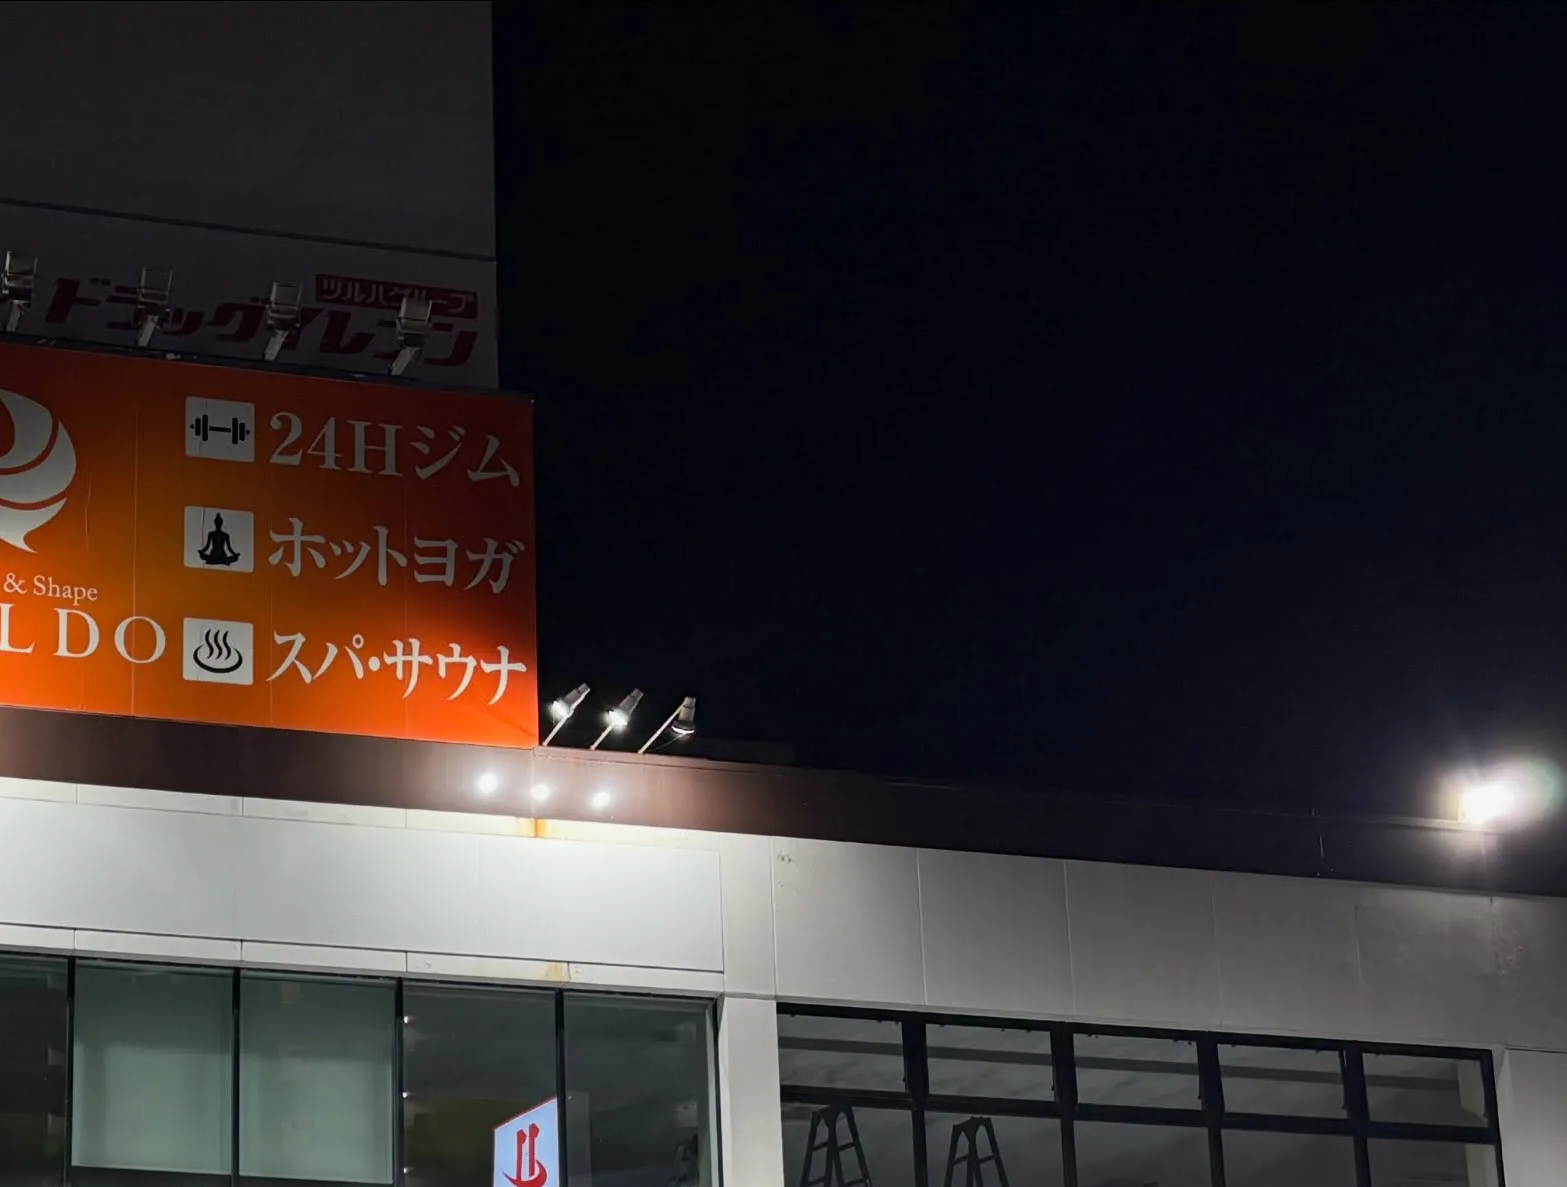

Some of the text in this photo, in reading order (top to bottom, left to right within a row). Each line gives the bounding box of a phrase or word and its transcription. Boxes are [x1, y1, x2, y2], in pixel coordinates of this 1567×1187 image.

[268, 411, 520, 488] 24Hジム
[33, 575, 98, 601] Shape
[268, 517, 524, 594] ホットヨガ
[265, 632, 527, 705] スパ・サウナ
